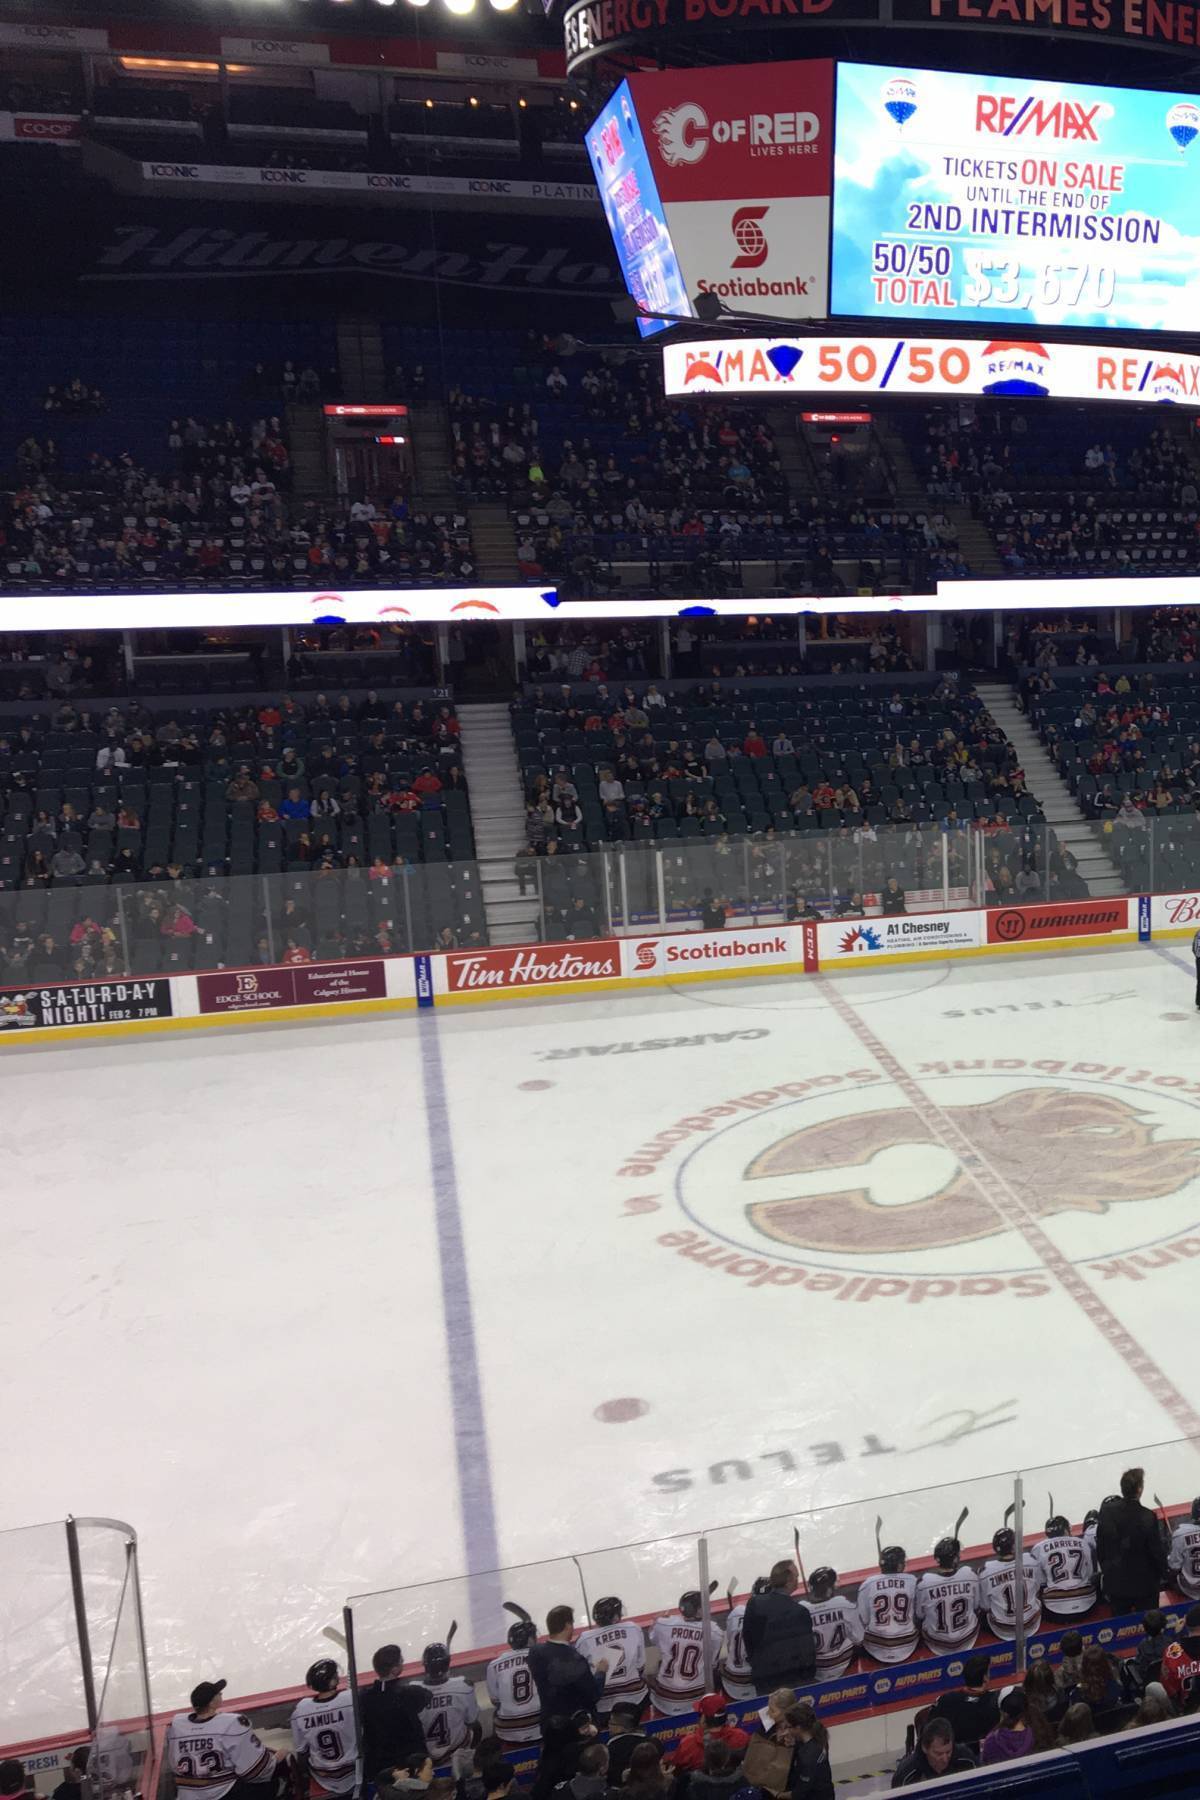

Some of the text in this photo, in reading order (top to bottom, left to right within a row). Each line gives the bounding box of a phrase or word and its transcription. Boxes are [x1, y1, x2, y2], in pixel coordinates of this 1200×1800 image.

[251, 41, 298, 53] ICONIC
[464, 55, 508, 69] ICONIC
[712, 120, 746, 143] OF
[750, 111, 820, 145] RED
[975, 94, 1100, 141] RE/MAX
[22, 122, 72, 135] CO-OP
[750, 144, 819, 157] LIVES HERE
[151, 164, 199, 178] ICONIC
[260, 169, 306, 183] ICONIC
[943, 157, 1124, 192] TICKETS ON SALE
[367, 175, 410, 189] ICONIC
[468, 181, 511, 194] ICONIC
[967, 186, 1109, 210] UNTIL THE END OF
[907, 203, 1161, 244] 2ND INTERMISSION
[874, 243, 951, 277] 50/50
[697, 276, 808, 297] Scotiabank
[871, 277, 955, 307] TOTAL
[818, 342, 971, 388] 50/50
[988, 360, 1045, 376] RE/MAX
[887, 921, 950, 935] A1 Chesney
[1030, 911, 1120, 929] WARRIOR
[666, 937, 787, 962] Scotiabank
[806, 927, 815, 960] CCM
[308, 969, 348, 979] Educational
[452, 952, 614, 987] Tim Hortons
[40, 982, 156, 1008] S-A-T-U-R-D-A-Y
[216, 991, 282, 1004] EDGE SCHOOL
[41, 1004, 158, 1025] NIGHT! FEB 2 7 PM
[941, 999, 1072, 1018] TELUS
[615, 1068, 882, 1178] Saddledome
[656, 1229, 1050, 1303] Saddledome
[652, 1434, 897, 1493] TELUS
[1044, 1539, 1084, 1550] CARRIERE
[1048, 1550, 1084, 1584] 27
[876, 1578, 905, 1590] ELDER
[928, 1582, 971, 1600] KASTELIC
[873, 1593, 909, 1627] 29
[936, 1597, 968, 1633] 12
[595, 1629, 627, 1647] KREBS
[664, 1643, 700, 1681] 10
[512, 1669, 534, 1705] 8
[895, 1674, 918, 1688] AUTO
[918, 1668, 942, 1683] PARTS
[819, 1685, 867, 1704] AUTO PARTS
[304, 1711, 345, 1730] ZAMULA
[178, 1737, 215, 1752] PETERS
[317, 1729, 343, 1762] 9
